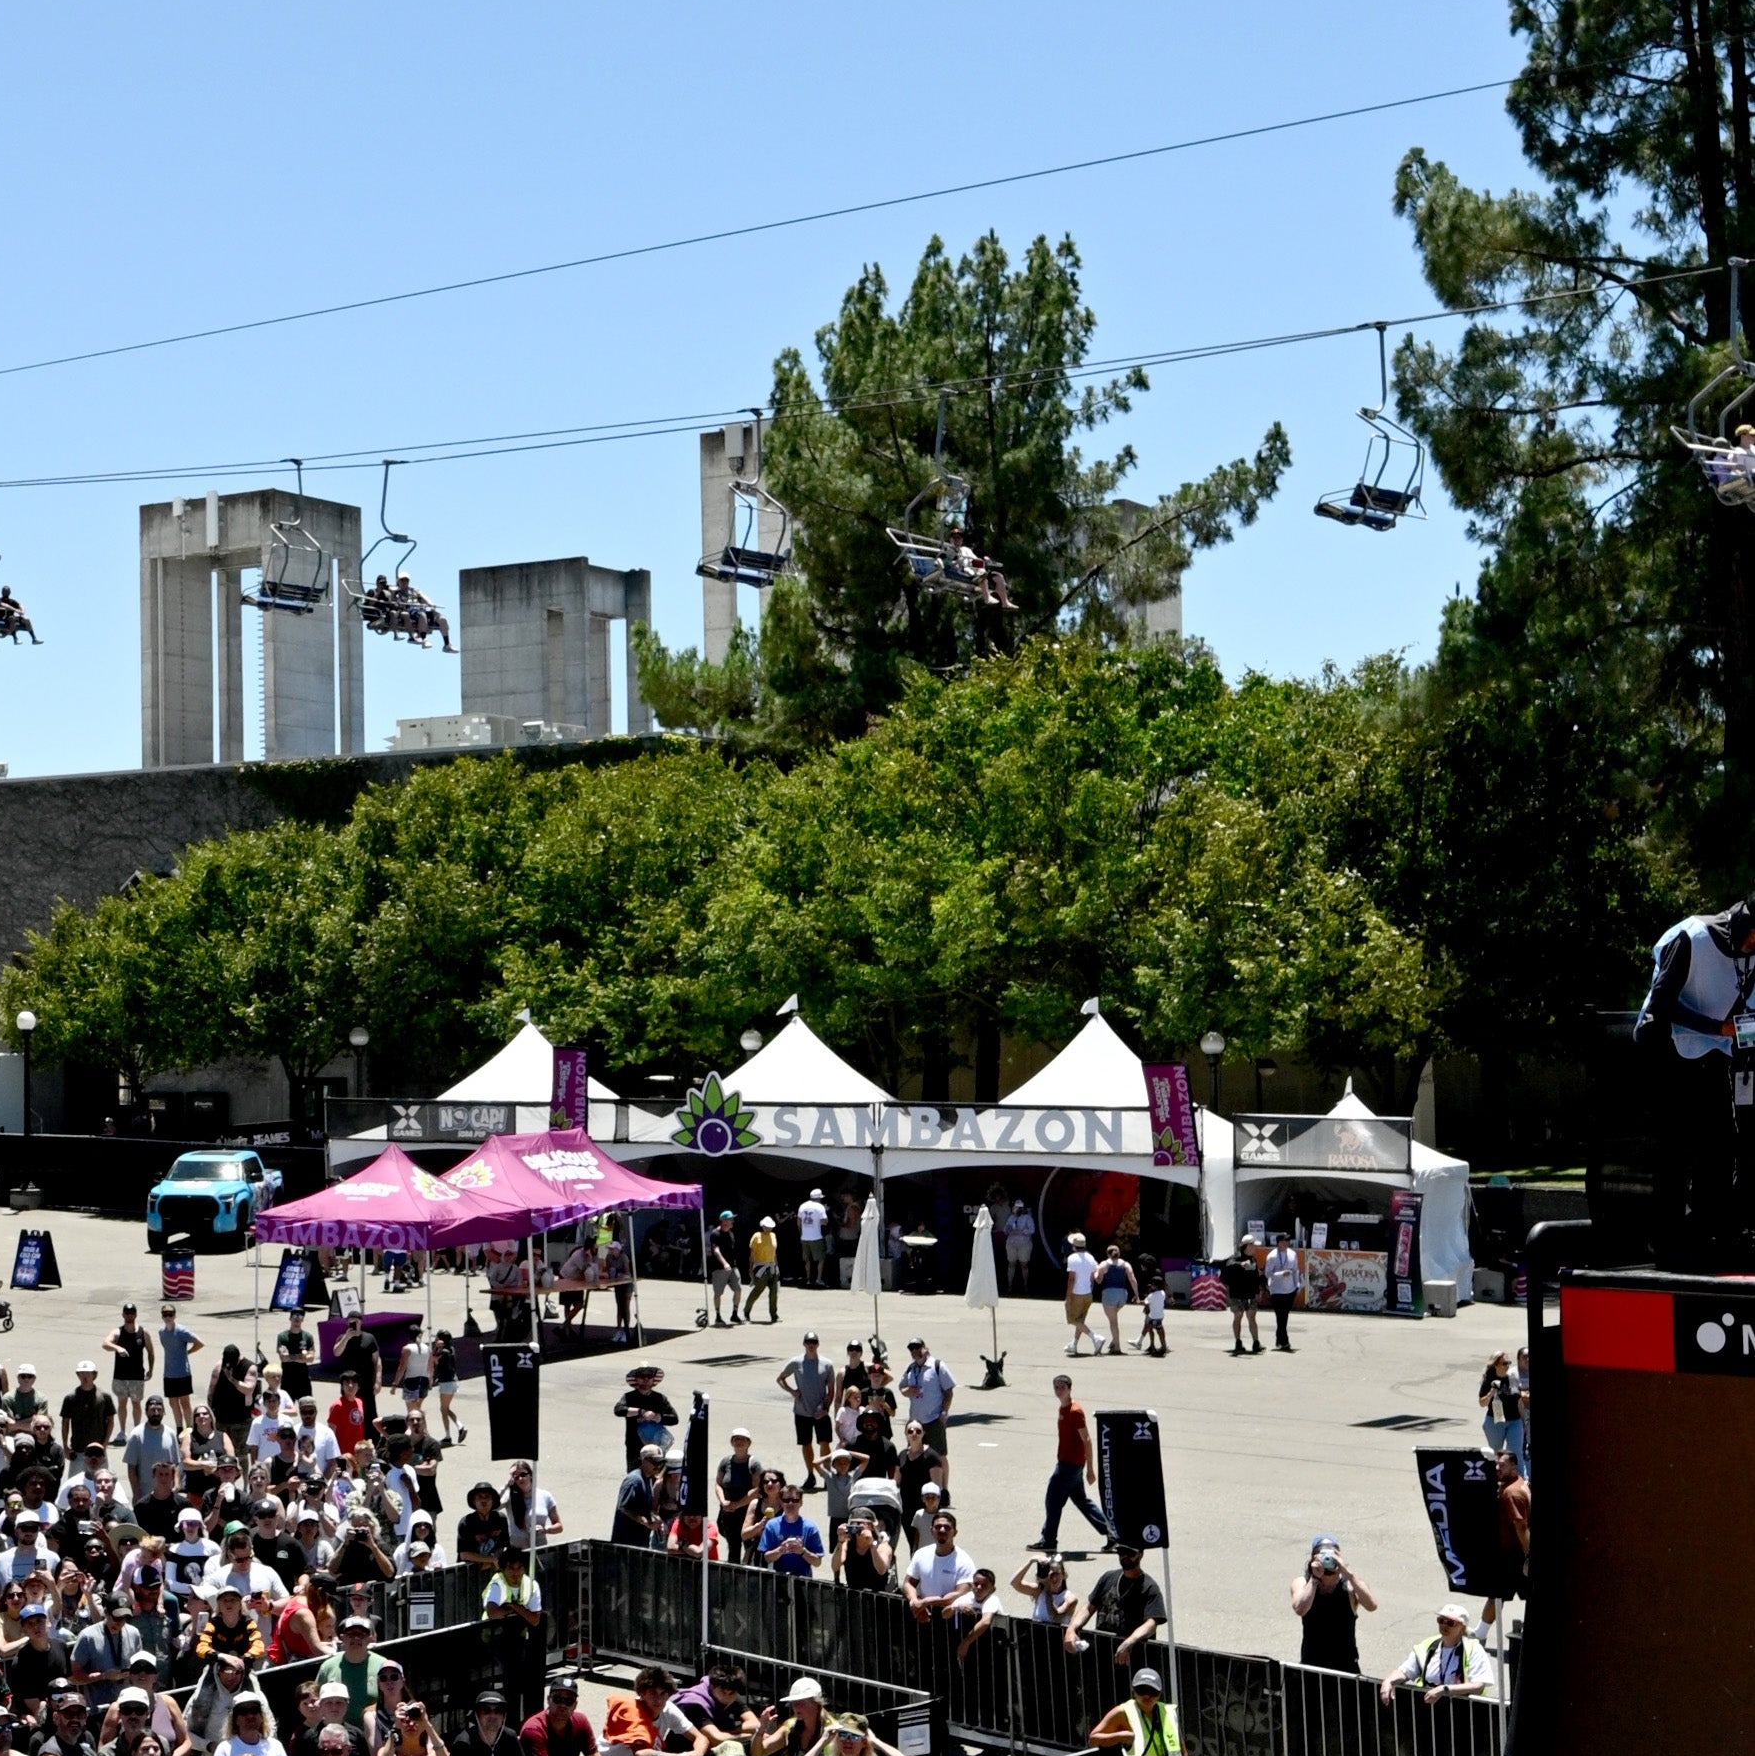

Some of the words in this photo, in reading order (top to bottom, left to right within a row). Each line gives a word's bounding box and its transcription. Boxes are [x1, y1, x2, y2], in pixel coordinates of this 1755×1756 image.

[574, 1051, 587, 1128] MBAZON
[470, 1106, 508, 1132] CAP!
[773, 1106, 1123, 1153] SAMBAZON
[1173, 1065, 1199, 1166] SAMBAZON
[392, 1129, 423, 1137] GAMES
[1240, 1152, 1281, 1162] GAMES
[1328, 1153, 1377, 1169] RAPOSA
[255, 1218, 428, 1251] SAMBAZON
[490, 1354, 506, 1398] VIP
